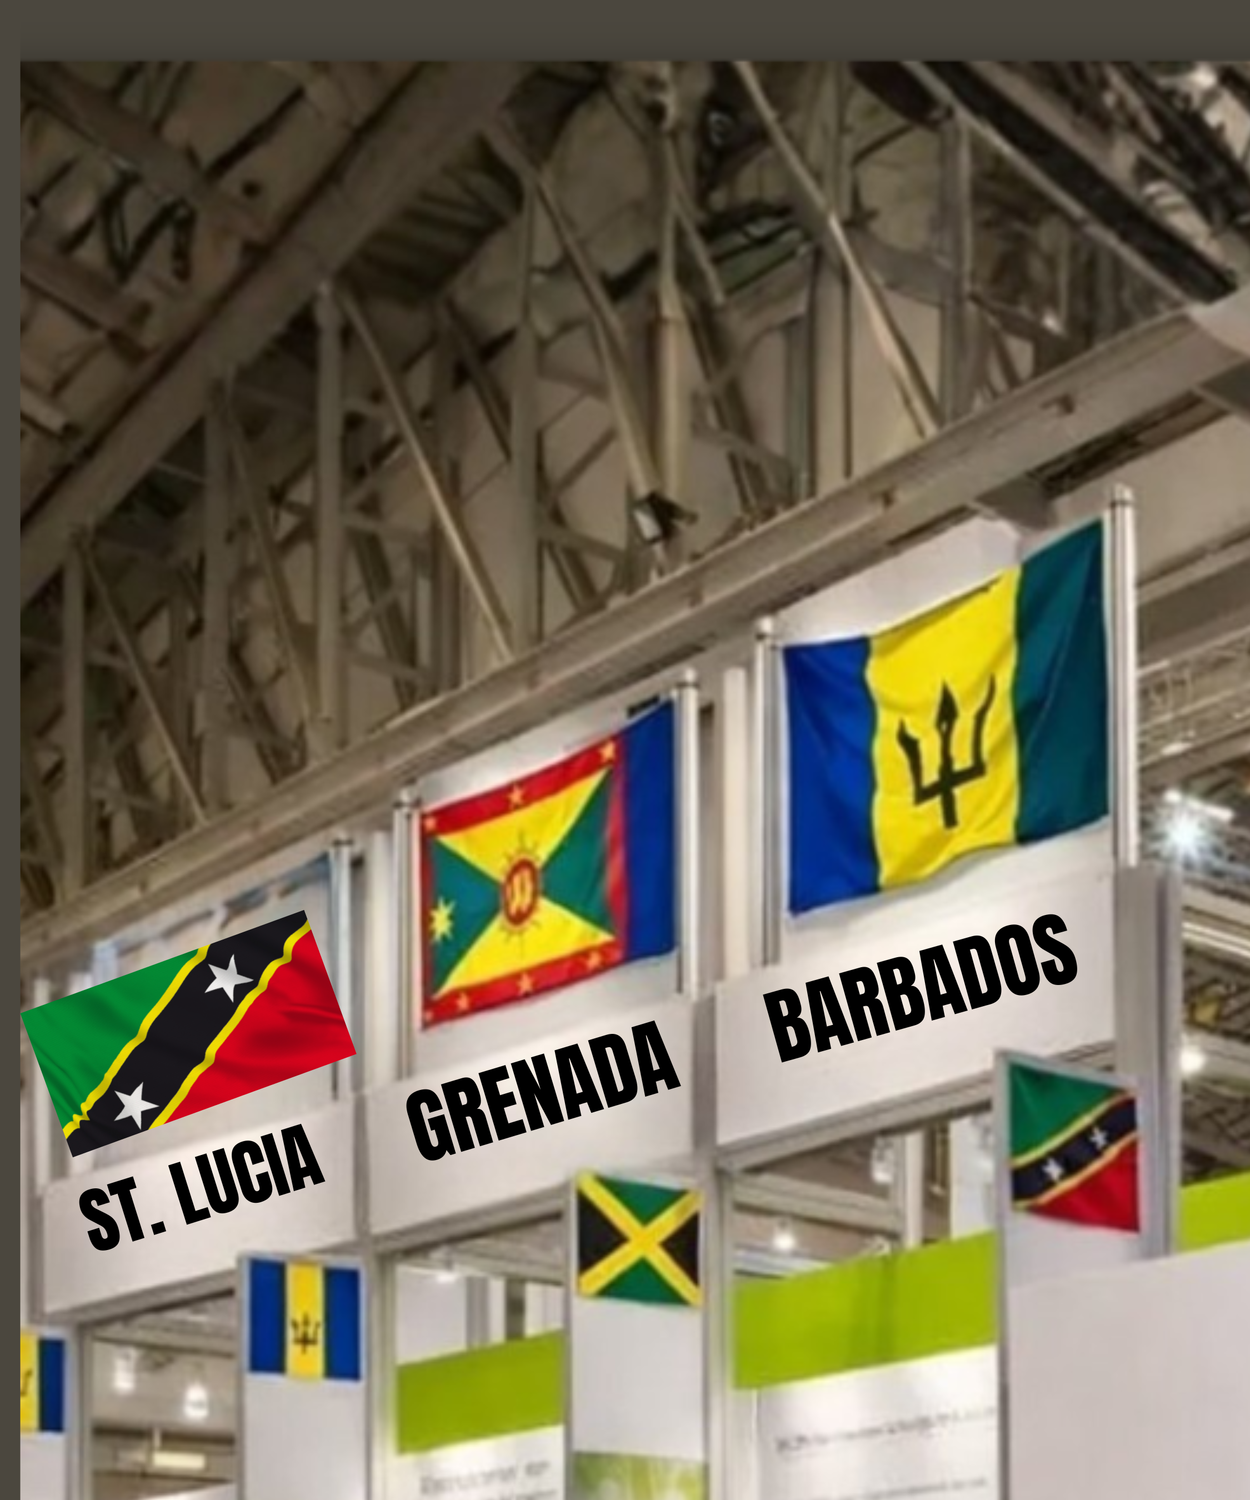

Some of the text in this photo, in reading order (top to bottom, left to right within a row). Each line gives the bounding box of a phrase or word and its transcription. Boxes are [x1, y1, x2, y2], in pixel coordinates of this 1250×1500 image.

[763, 914, 1078, 1063] BARBADOS
[406, 1020, 681, 1161] GRENADA
[79, 1123, 326, 1251] ST. LUCIA
